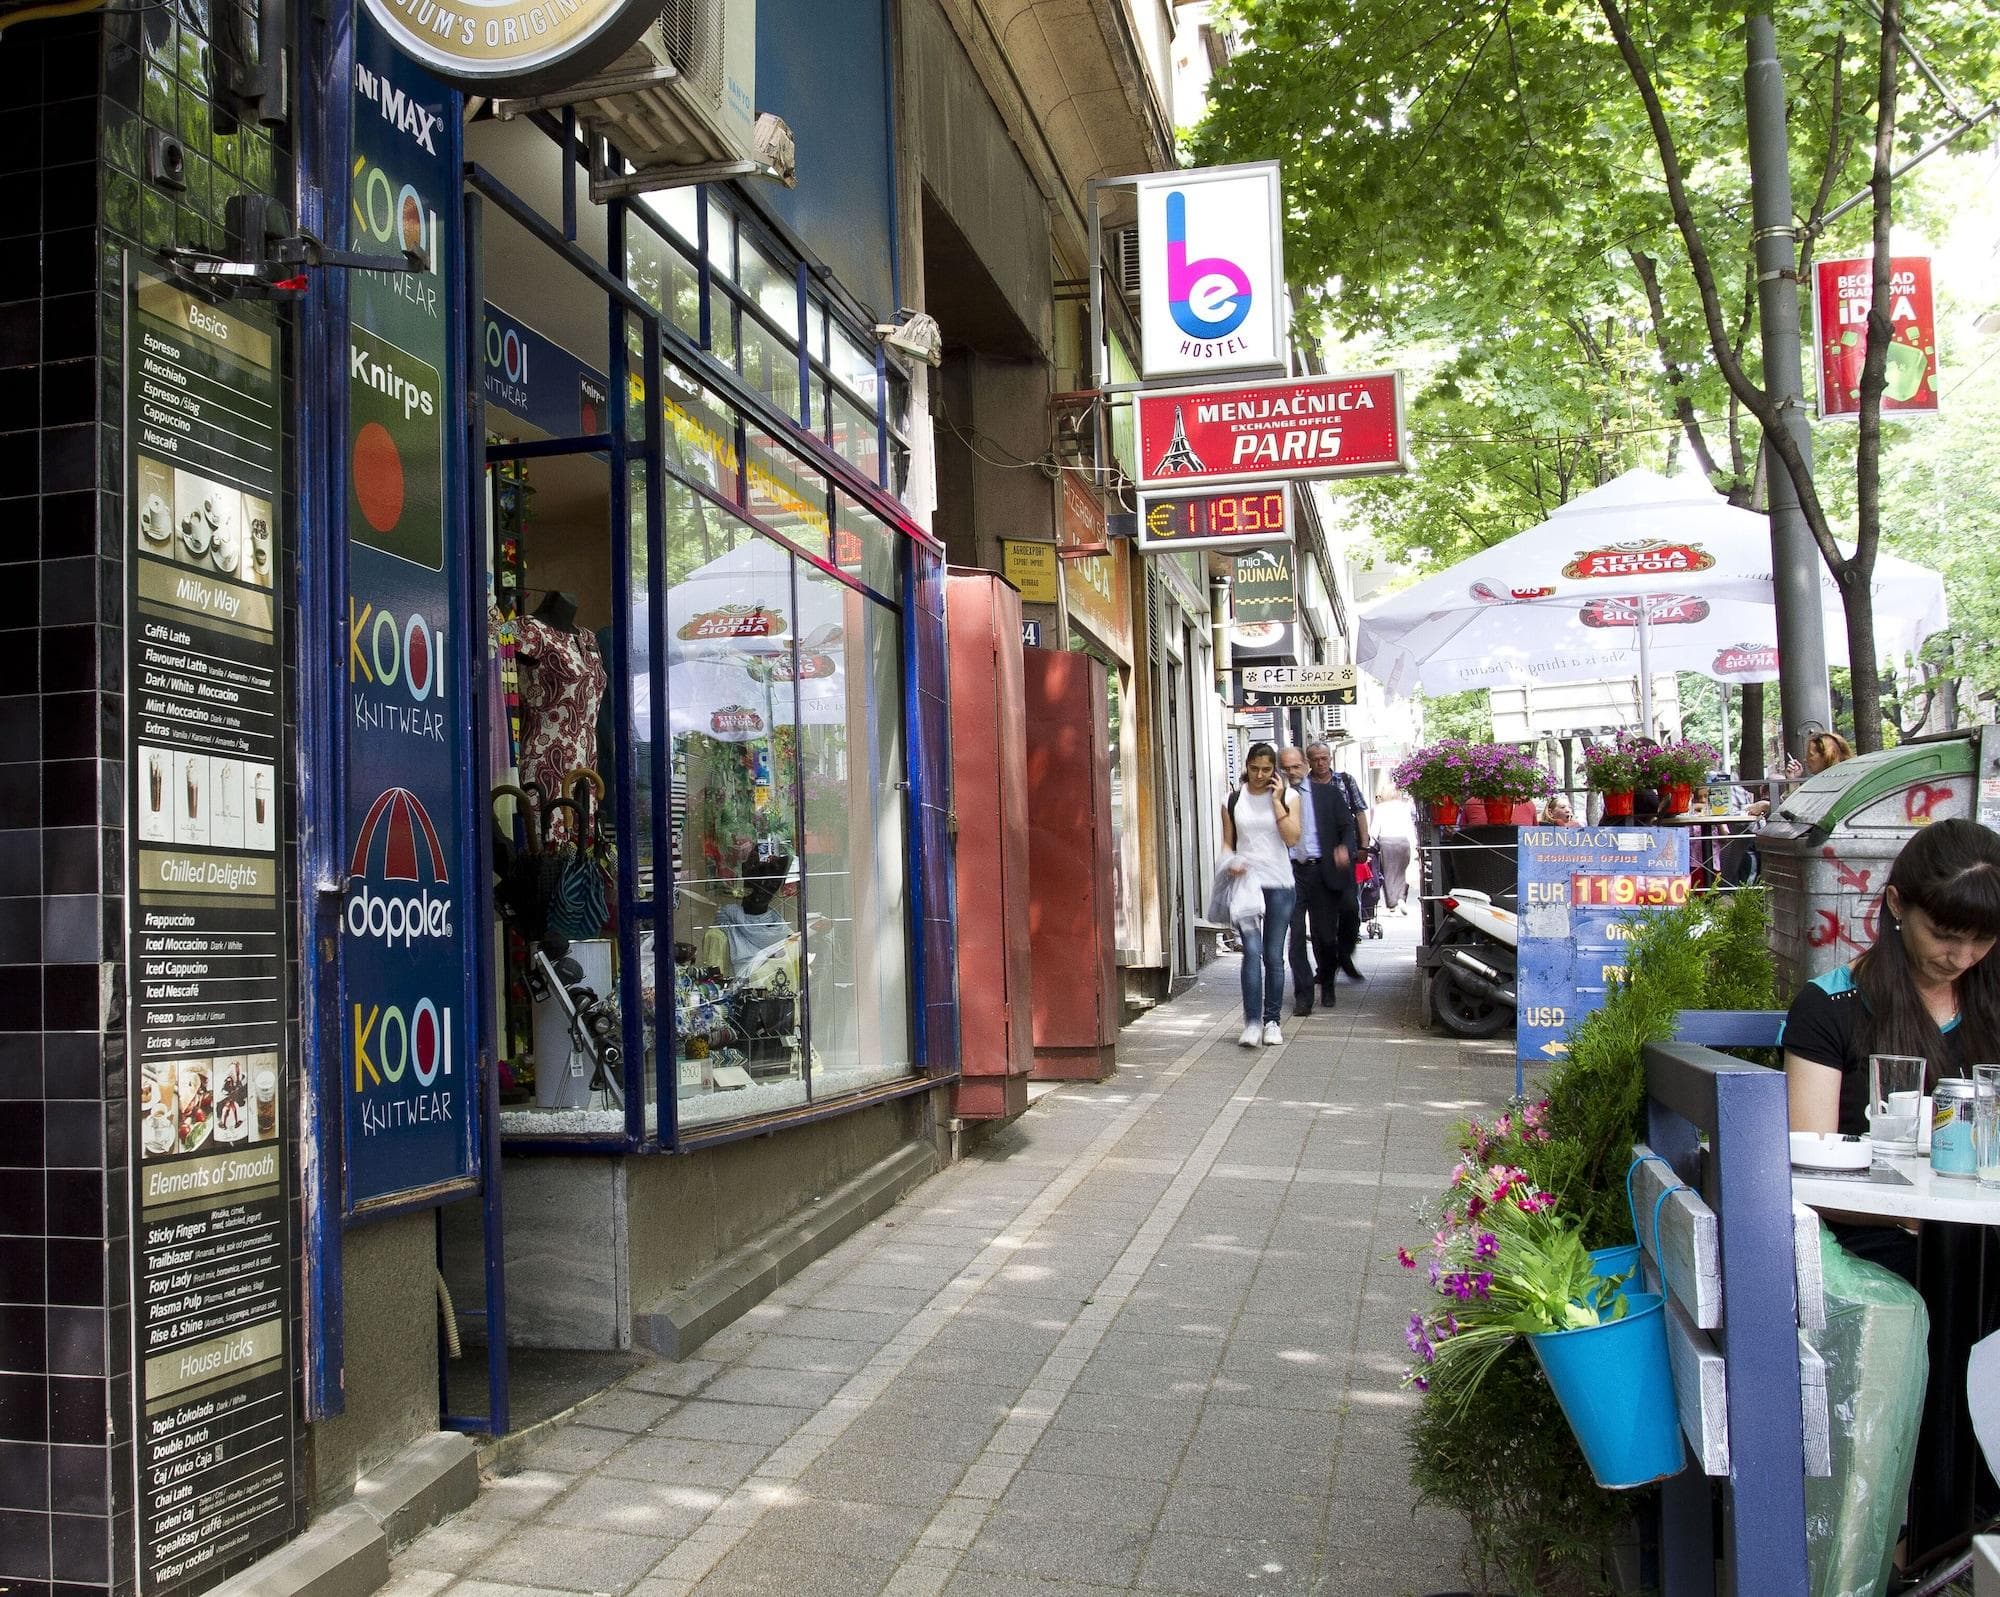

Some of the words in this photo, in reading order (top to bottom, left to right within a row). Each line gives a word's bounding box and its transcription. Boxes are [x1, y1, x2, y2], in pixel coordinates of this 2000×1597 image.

[395, 0, 476, 45] IUM'S
[1837, 272, 1914, 289] BEOAD
[189, 304, 228, 340] Basics
[1839, 296, 1917, 325] iDA
[144, 334, 180, 359] Espresso
[486, 321, 528, 385] OOI
[1180, 336, 1248, 358] HOSTEL
[144, 358, 187, 386] Macchiato
[351, 344, 433, 419] Knirps
[144, 403, 191, 432] Cappuccino
[1198, 389, 1374, 424] MENJAČNICA
[1231, 419, 1296, 432] EXCHANGE
[1300, 415, 1342, 426] OFFICE
[144, 429, 178, 452] Nescafé
[1232, 427, 1343, 465] PARIS
[1237, 557, 1260, 569] linija
[1238, 556, 1289, 583] DUNAVA
[1588, 558, 1688, 574] ARTOIS
[1591, 550, 1687, 567] STELLA
[176, 578, 211, 610] Milky
[214, 588, 240, 617] Way
[145, 624, 168, 640] Caffé
[170, 629, 191, 645] Latte
[145, 648, 185, 667] Flavoured
[187, 658, 207, 673] Latte
[1264, 668, 1297, 683] PET
[1301, 670, 1335, 682] ŠPAJZ
[198, 683, 239, 702] Moccacino
[1273, 696, 1282, 705] U
[1286, 693, 1325, 705] PASAŽU
[145, 699, 166, 713] Mint
[166, 702, 209, 721] Moccacino
[354, 693, 445, 743] KNITWEAR
[145, 721, 170, 736] Extras
[1524, 829, 1657, 848] MENJAČNA
[1536, 854, 1594, 864] EXCHANGE
[1600, 855, 1638, 864] OFFICE
[161, 860, 204, 883] Chilled
[207, 863, 257, 890] Delights
[1527, 882, 1564, 902] EUR
[145, 913, 195, 929] Frappuccino
[348, 885, 450, 947] doppler
[145, 938, 164, 950] Iced
[165, 938, 208, 951] Moccacino
[146, 962, 165, 975] Iced
[146, 985, 165, 998] Iced
[166, 984, 199, 998] Nescafé
[147, 1012, 173, 1024] Freezo
[1527, 1008, 1564, 1027] USD
[147, 1037, 172, 1048] Extras
[354, 997, 451, 1092] KOOI
[361, 1092, 452, 1136] KNITWEAR
[150, 1170, 209, 1196] Elements
[212, 1160, 227, 1184] of
[227, 1154, 274, 1182] Smooth
[148, 1227, 175, 1245] Sticky
[175, 1222, 206, 1240] Fingers
[148, 1250, 194, 1270] Trailblazer
[149, 1279, 170, 1294] Foxy
[171, 1272, 192, 1288] Lady
[150, 1302, 181, 1319] Plasma
[183, 1294, 202, 1311] Pulp
[150, 1330, 168, 1345] Rise
[170, 1325, 178, 1338] &
[180, 1319, 203, 1336] Shine
[180, 1350, 221, 1379] House
[224, 1338, 253, 1361] Licks
[152, 1417, 175, 1435] Topla
[177, 1403, 214, 1425] Čokolada
[153, 1439, 183, 1460] Double
[185, 1428, 209, 1448] Dutch
[154, 1469, 168, 1486] Čaj
[174, 1459, 194, 1477] Kuća
[195, 1451, 212, 1468] Čaja
[155, 1493, 172, 1509] Chai
[174, 1485, 193, 1502] Latte
[155, 1512, 181, 1534] Ledeni
[183, 1506, 195, 1522] čaj
[156, 1529, 199, 1559] SpeakEasy
[201, 1515, 222, 1537] caffé
[156, 1559, 184, 1583] VitEasy
[185, 1544, 215, 1569] cocktail
